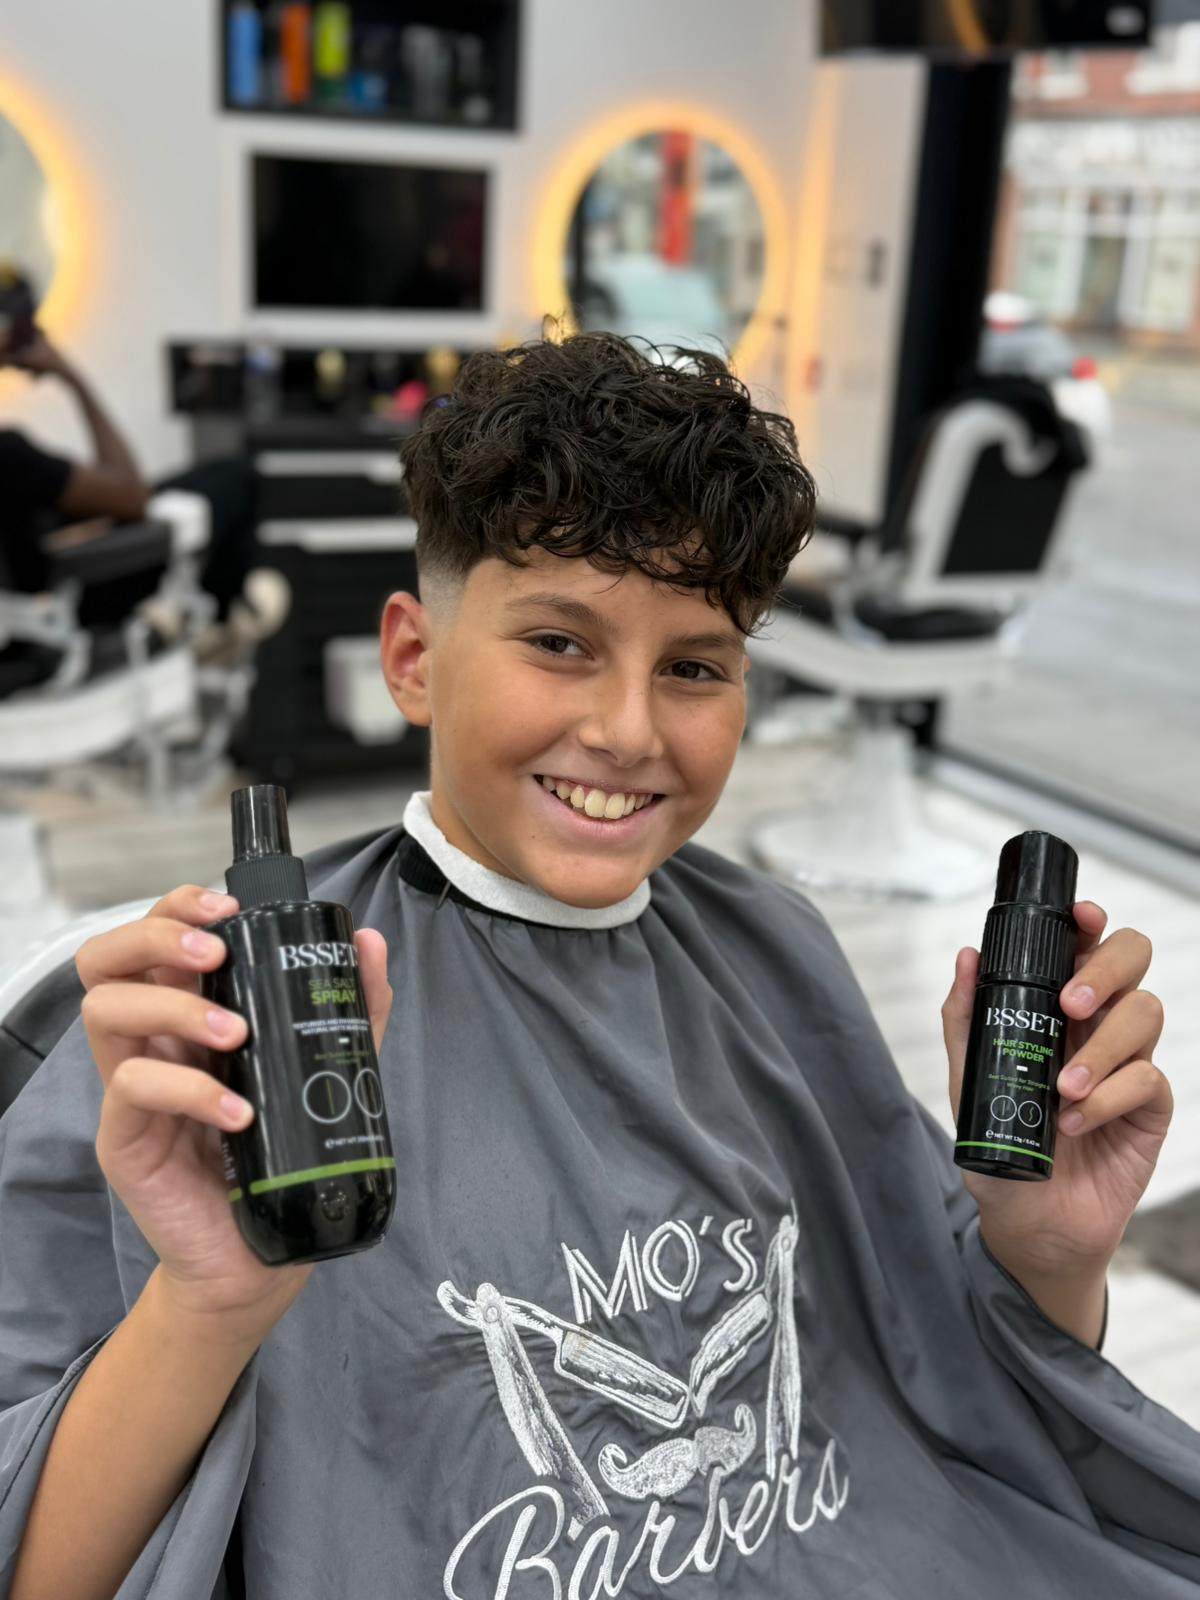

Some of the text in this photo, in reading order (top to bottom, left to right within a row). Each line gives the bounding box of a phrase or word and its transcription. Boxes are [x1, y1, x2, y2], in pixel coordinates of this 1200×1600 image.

[311, 989, 356, 1005] SPRAY
[993, 1038, 1054, 1057] HAIR STYLING
[1003, 1048, 1045, 1063] POWDER
[561, 1215, 759, 1324] MO'S
[443, 1439, 850, 1600] Barbers
